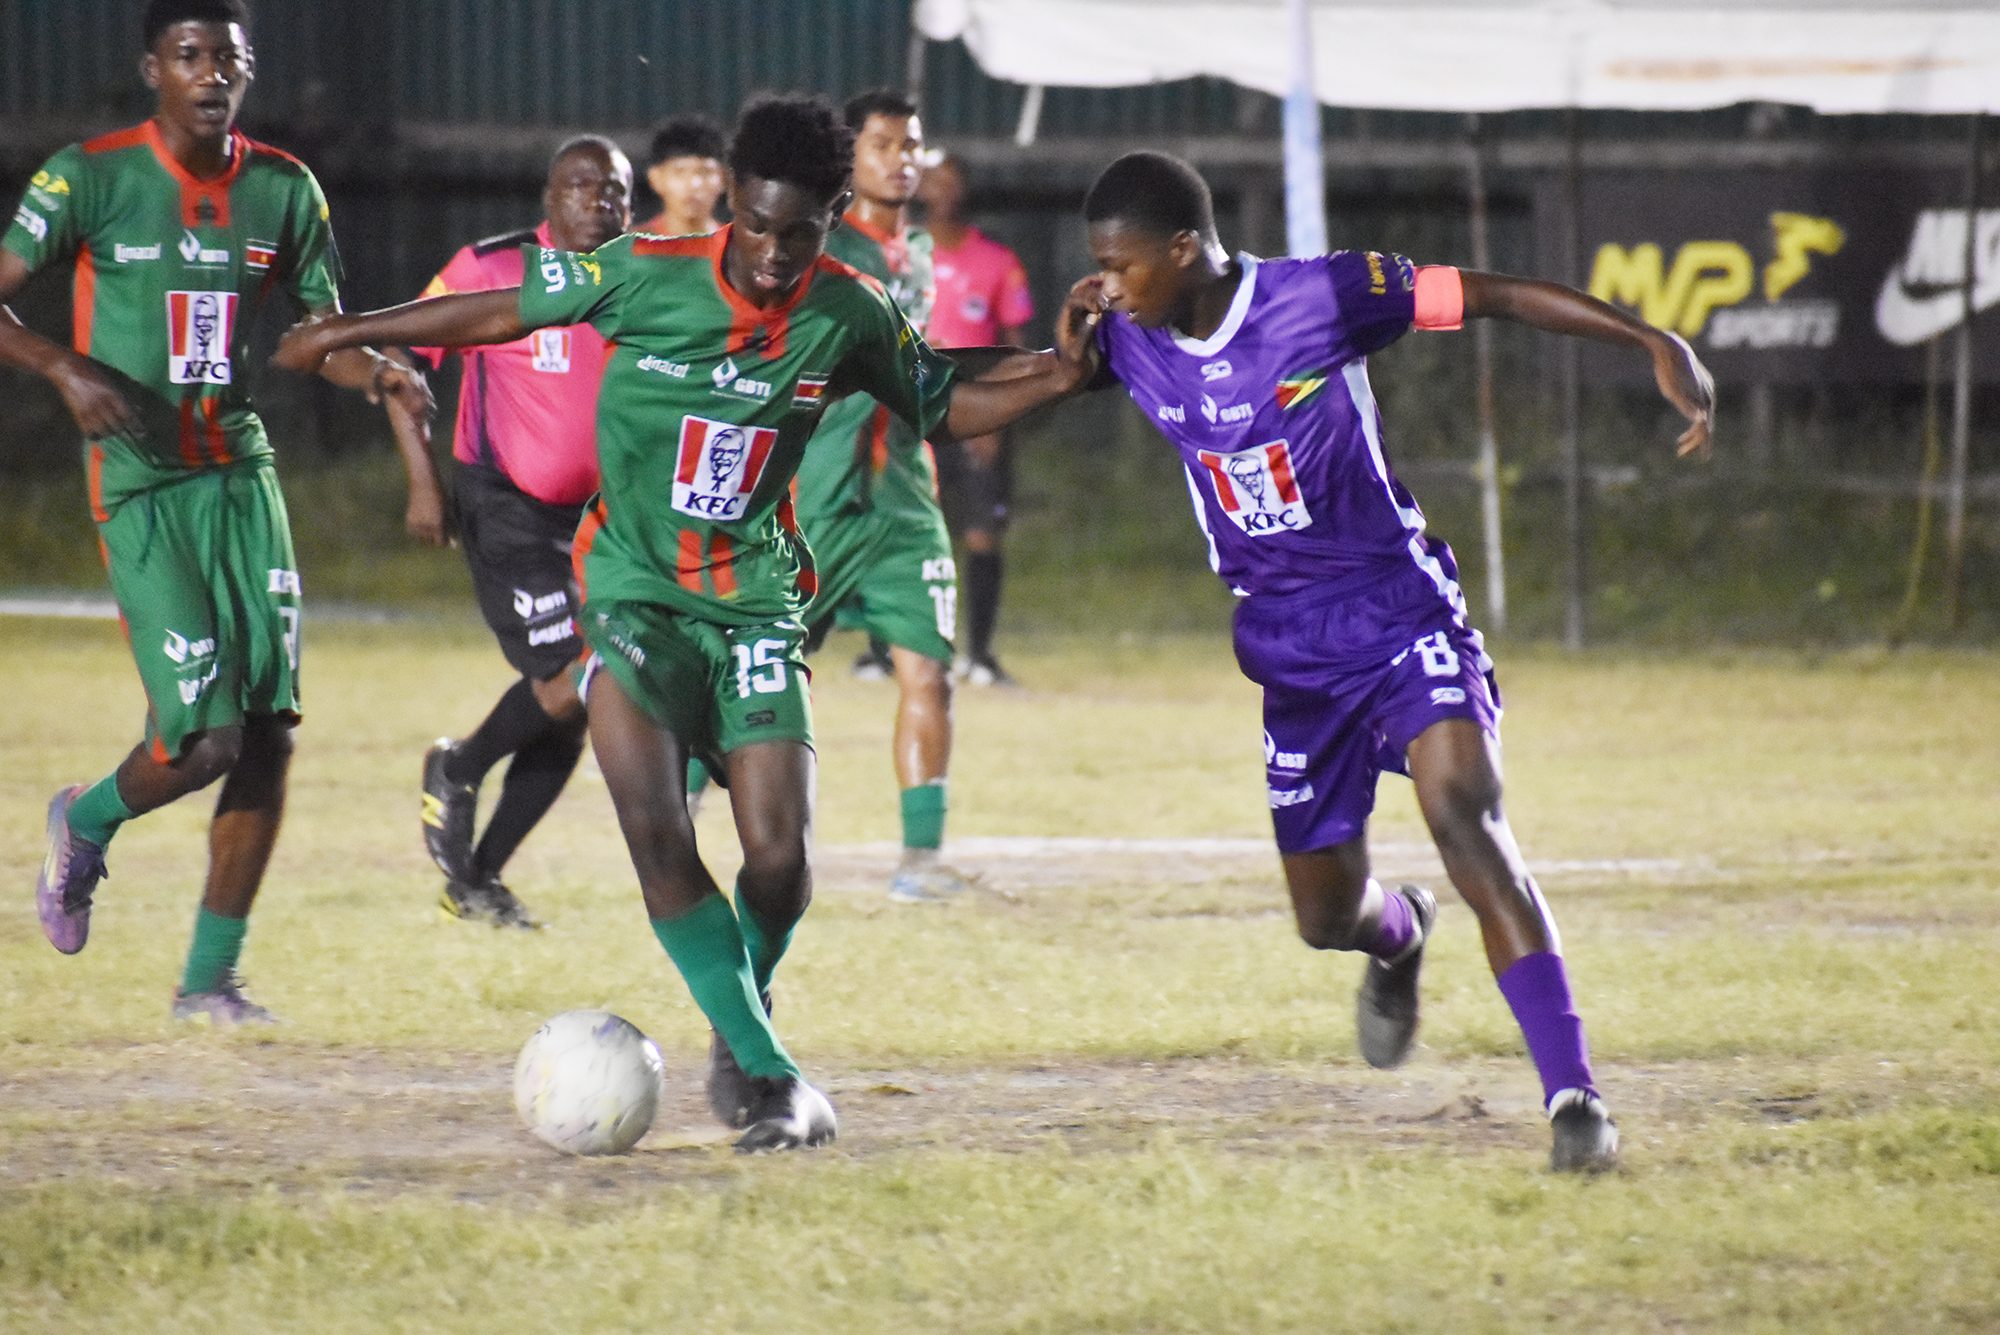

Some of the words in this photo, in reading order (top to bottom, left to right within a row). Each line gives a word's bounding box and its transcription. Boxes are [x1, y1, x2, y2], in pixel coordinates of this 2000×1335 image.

[1588, 240, 1755, 338] MVP
[182, 360, 227, 379] KFC
[734, 378, 772, 397] GBTI
[684, 491, 739, 516] KFC
[1242, 509, 1298, 533] KFC
[1413, 631, 1461, 677] 8
[730, 638, 787, 699] 15
